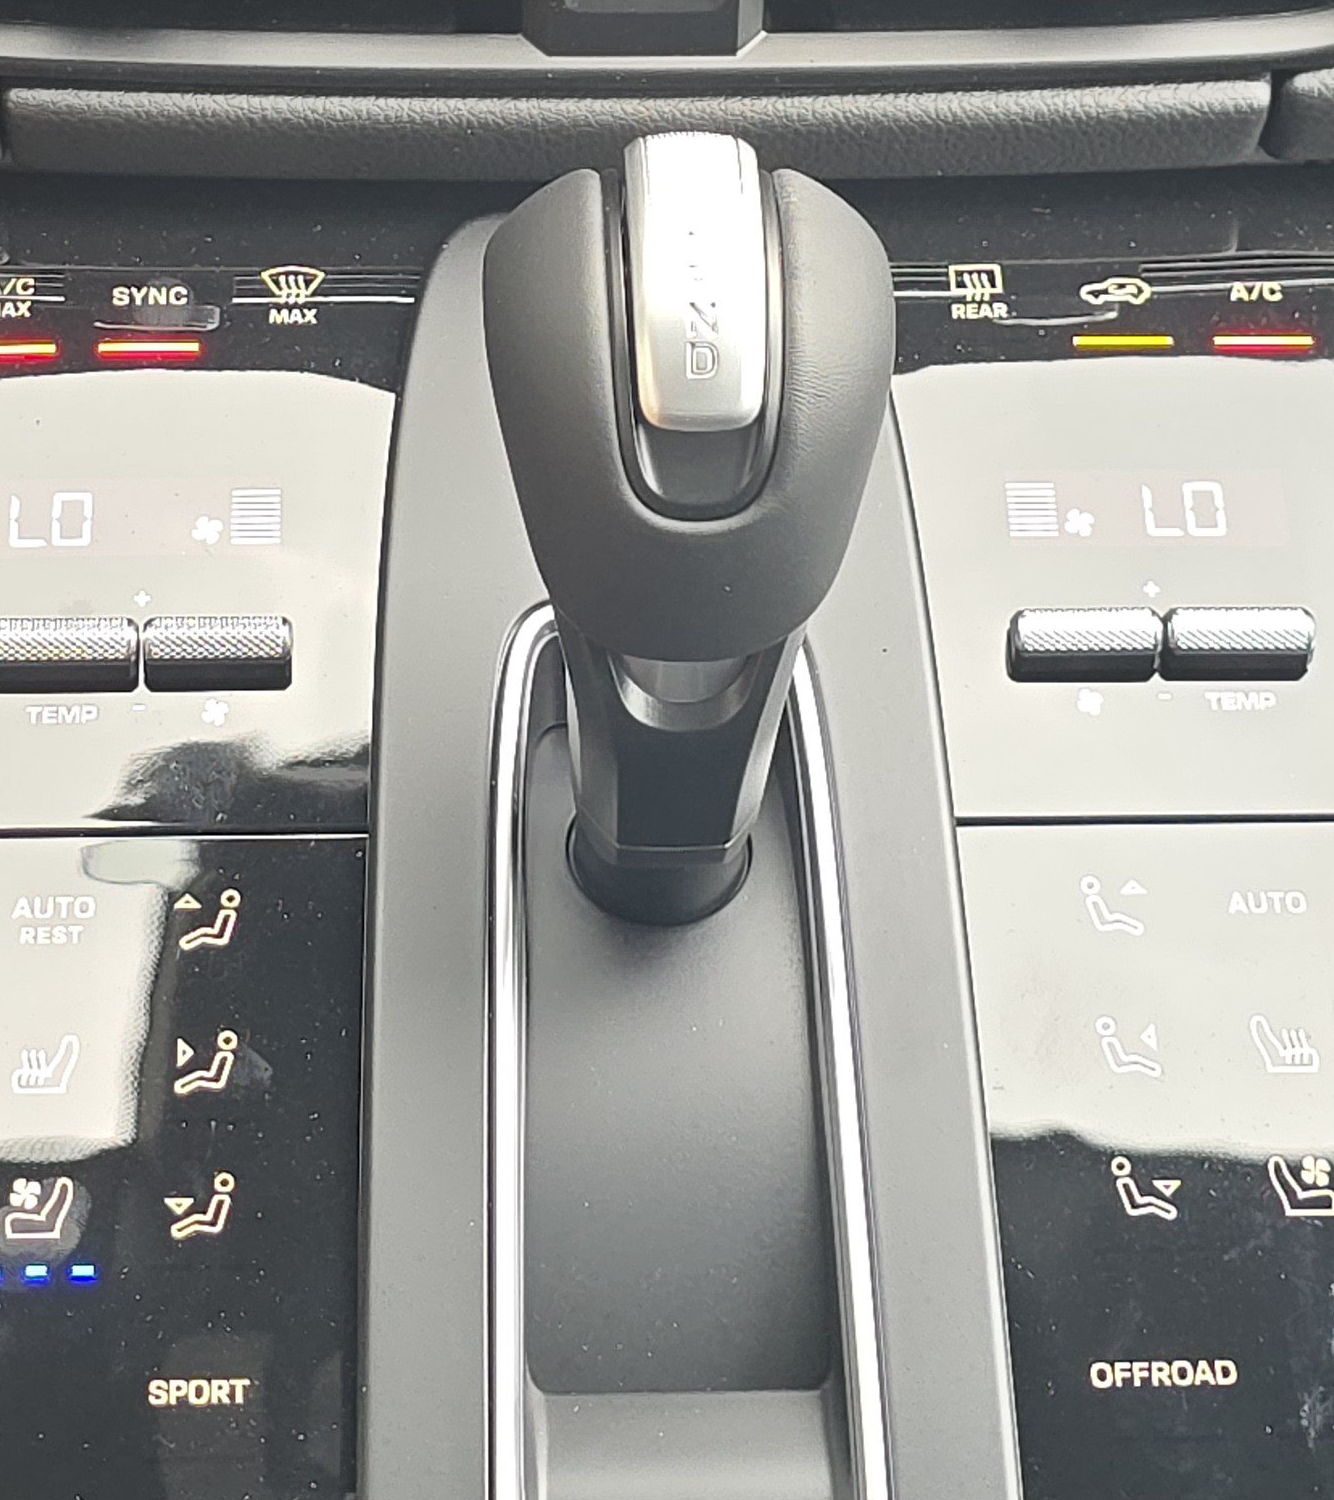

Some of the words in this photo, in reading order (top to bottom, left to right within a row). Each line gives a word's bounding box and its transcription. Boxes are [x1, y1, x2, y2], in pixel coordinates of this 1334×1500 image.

[112, 286, 188, 306] SYNC
[1230, 282, 1283, 302] A/C
[268, 308, 318, 325] MAX
[951, 303, 1008, 320] REAR
[1205, 691, 1277, 712] TEMP
[26, 704, 98, 725] TEMP
[12, 896, 95, 920] AUTO
[1228, 891, 1307, 914] AUTO
[19, 926, 83, 945] REST
[1090, 1360, 1238, 1388] OFFROAD
[148, 1379, 250, 1406] SPORT
